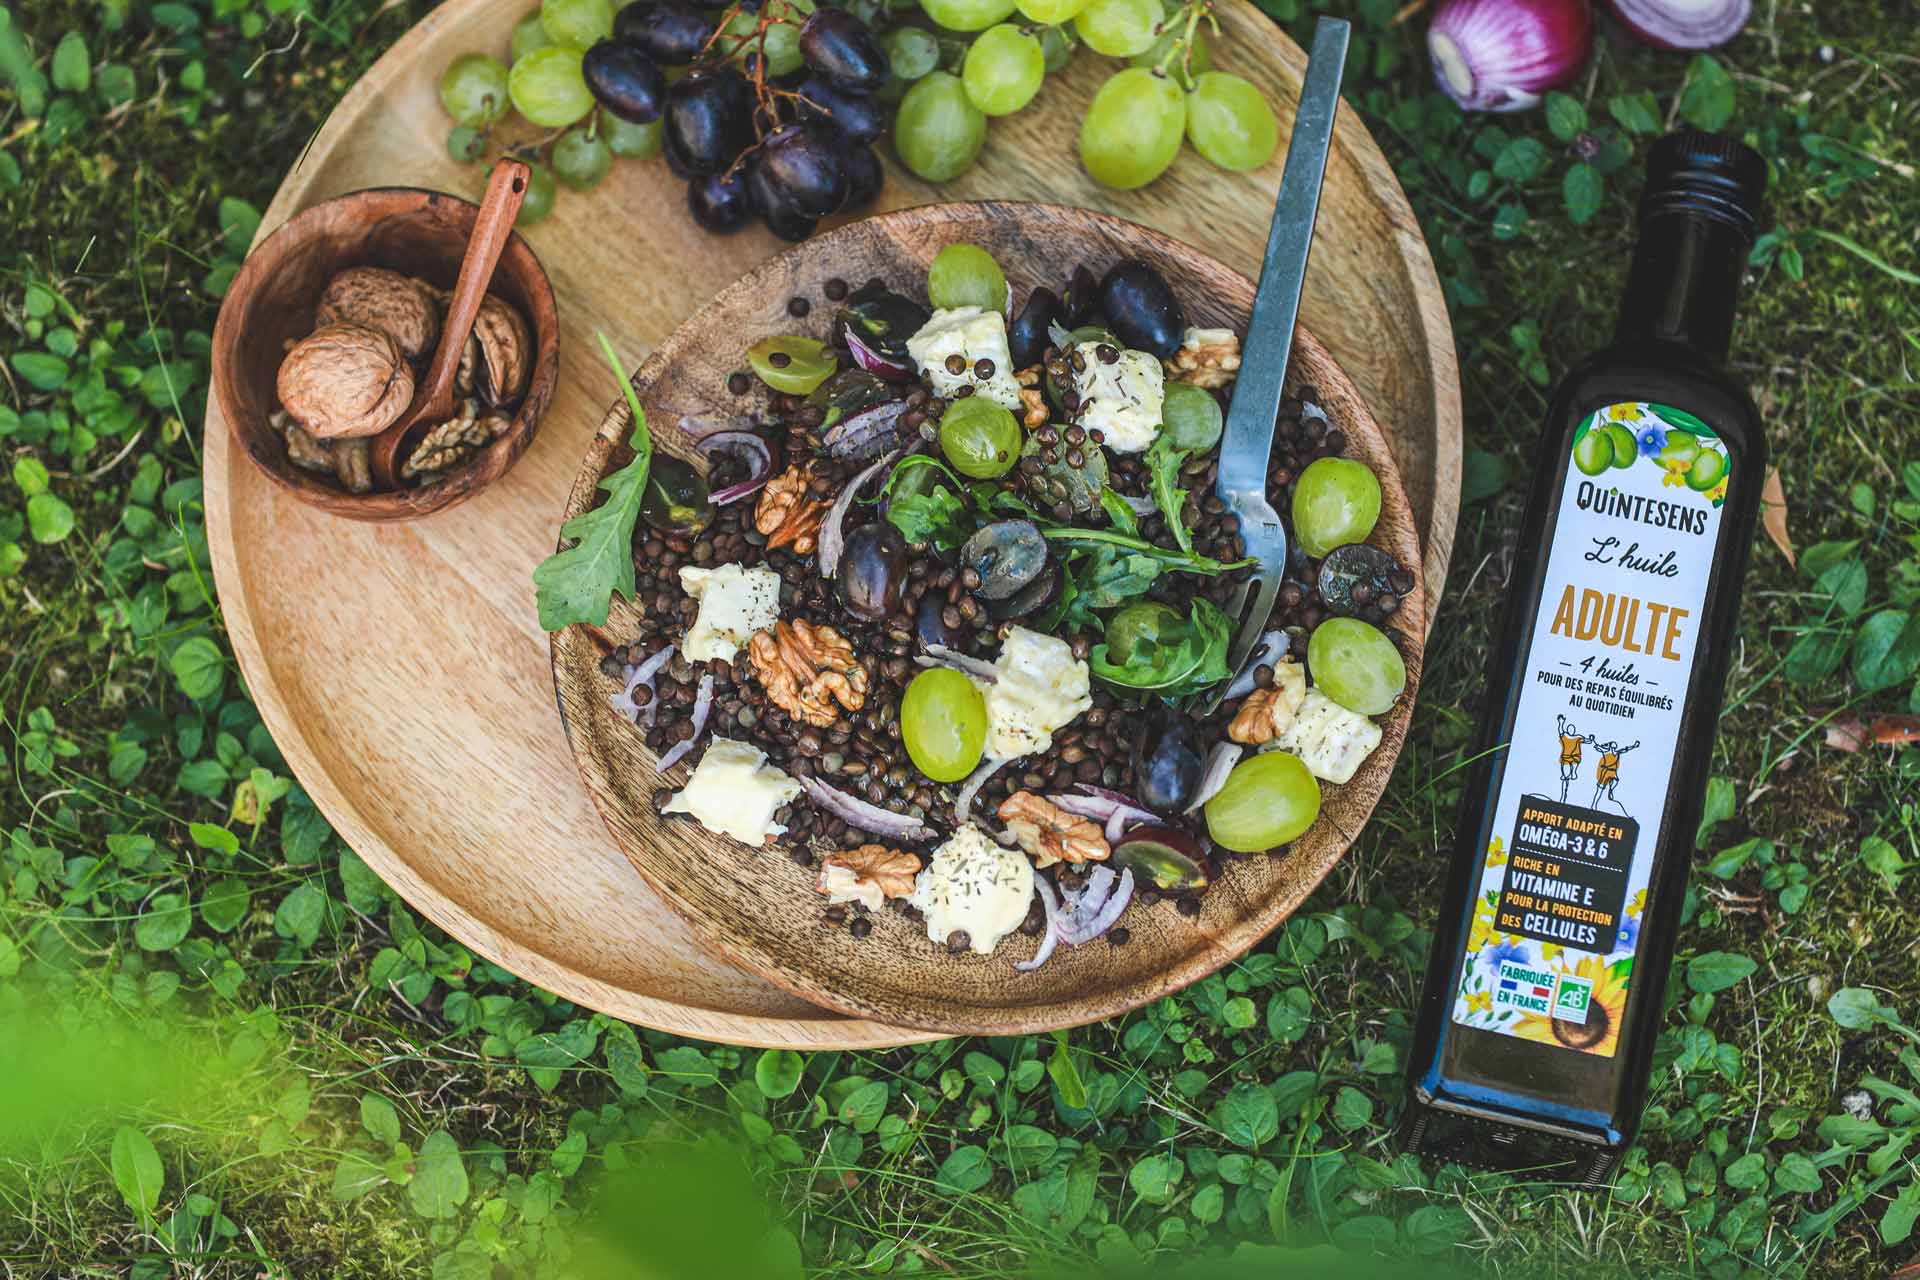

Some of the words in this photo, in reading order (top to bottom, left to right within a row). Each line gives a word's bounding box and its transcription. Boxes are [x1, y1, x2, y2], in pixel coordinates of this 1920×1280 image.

[1584, 536, 1679, 578] L'huile
[1551, 583, 1690, 661] ADULTE
[1579, 655, 1596, 674] 4
[1595, 657, 1640, 686] huiles
[1537, 670, 1563, 687] POUR
[1564, 676, 1584, 692] DES
[1585, 681, 1617, 699] REPAS
[1618, 685, 1673, 711] ÉQUILIBRÉS
[1569, 694, 1584, 708] AU
[1585, 697, 1636, 719] QUOTIDIEN
[1523, 808, 1563, 827] APPORT
[1566, 818, 1607, 838] ADAPTÉ
[1608, 827, 1623, 841] EN
[1519, 824, 1584, 854] OMÉGA-3
[1584, 837, 1596, 857] &
[1598, 841, 1609, 859] 6
[1513, 855, 1543, 873] RICHE
[1545, 863, 1560, 876] EN
[1511, 871, 1581, 903] VITAMINE
[1583, 887, 1595, 906] E
[1506, 892, 1533, 909] POUR
[1536, 900, 1549, 913] LA
[1552, 902, 1612, 926] PROTECTION
[1501, 913, 1521, 928] DES
[1523, 912, 1597, 945] CELLULES
[1500, 964, 1556, 988] FABRIQUÉE
[1497, 990, 1511, 1003] EN
[1512, 993, 1549, 1013] FRANCE
